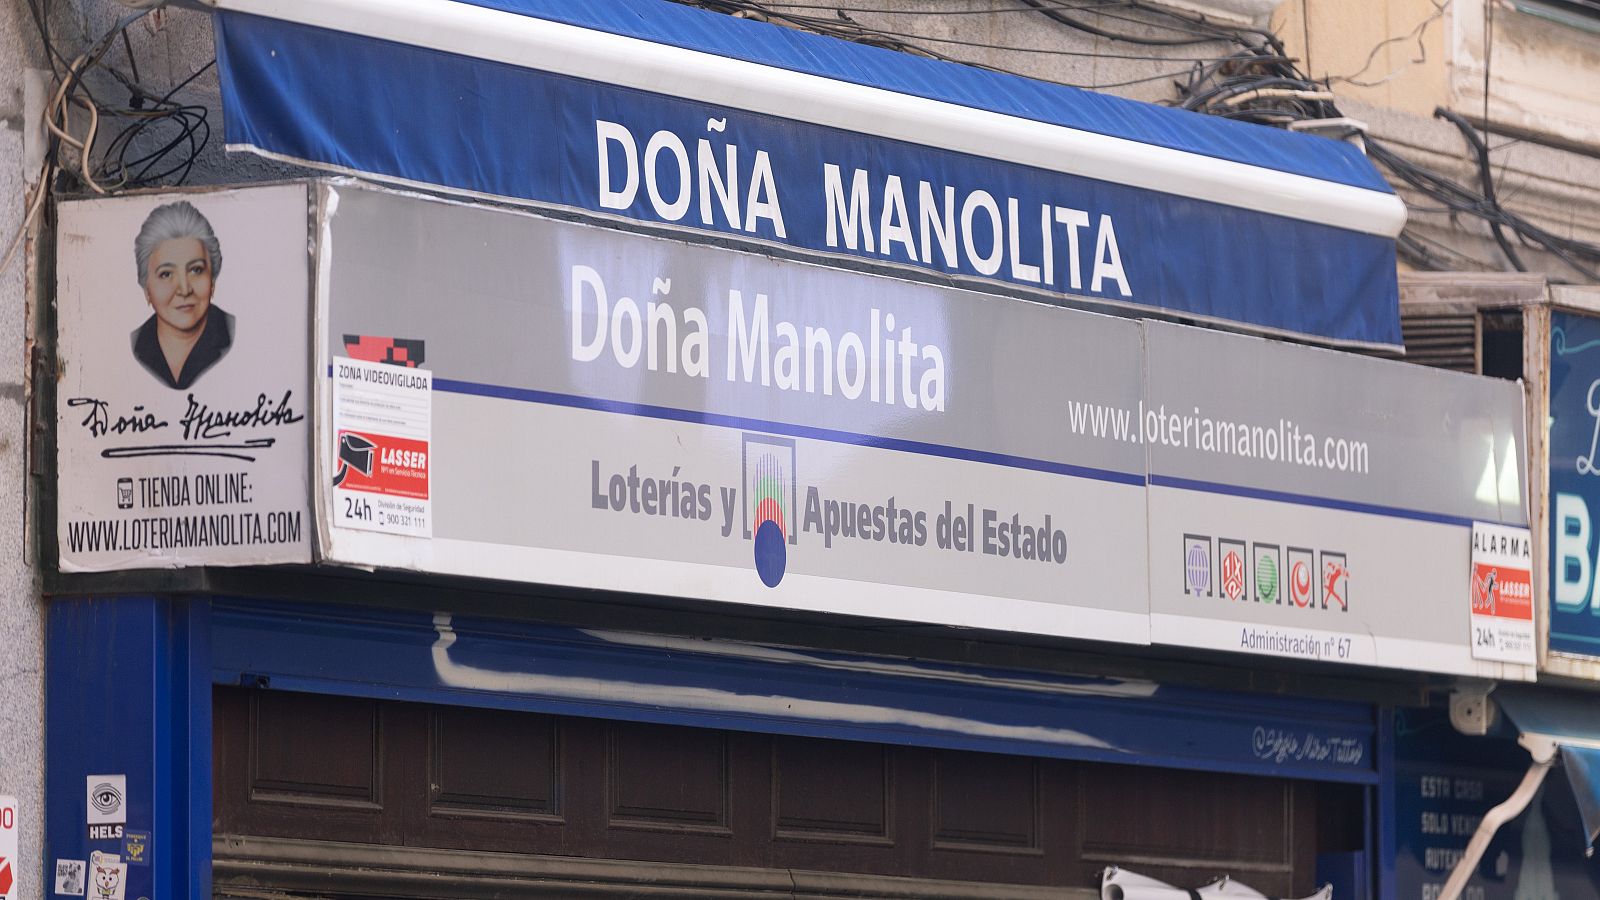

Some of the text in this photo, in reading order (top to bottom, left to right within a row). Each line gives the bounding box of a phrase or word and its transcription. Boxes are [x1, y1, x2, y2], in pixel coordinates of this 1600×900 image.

[596, 117, 1133, 297] DOÑA MANOLITA
[571, 264, 945, 412] Doña Manolita
[339, 365, 428, 391] ZONA VIDEOVIGILADA
[67, 390, 304, 441] Doña Manolita
[1068, 400, 1369, 474] www.loteriamanolita.com
[381, 447, 426, 470] LASSER
[138, 473, 253, 509] TIENDA ONLINE:
[345, 497, 372, 521] 24h
[387, 513, 425, 528] 900 321 111
[591, 460, 1067, 564] Loterías y Apuestas del Estado
[68, 512, 301, 553] WWW.LOTERIAMANOLITA.COM
[1474, 532, 1530, 557] ALARMA
[1241, 627, 1320, 657] Administración
[1338, 638, 1351, 659] 67
[89, 825, 123, 839] HELS
